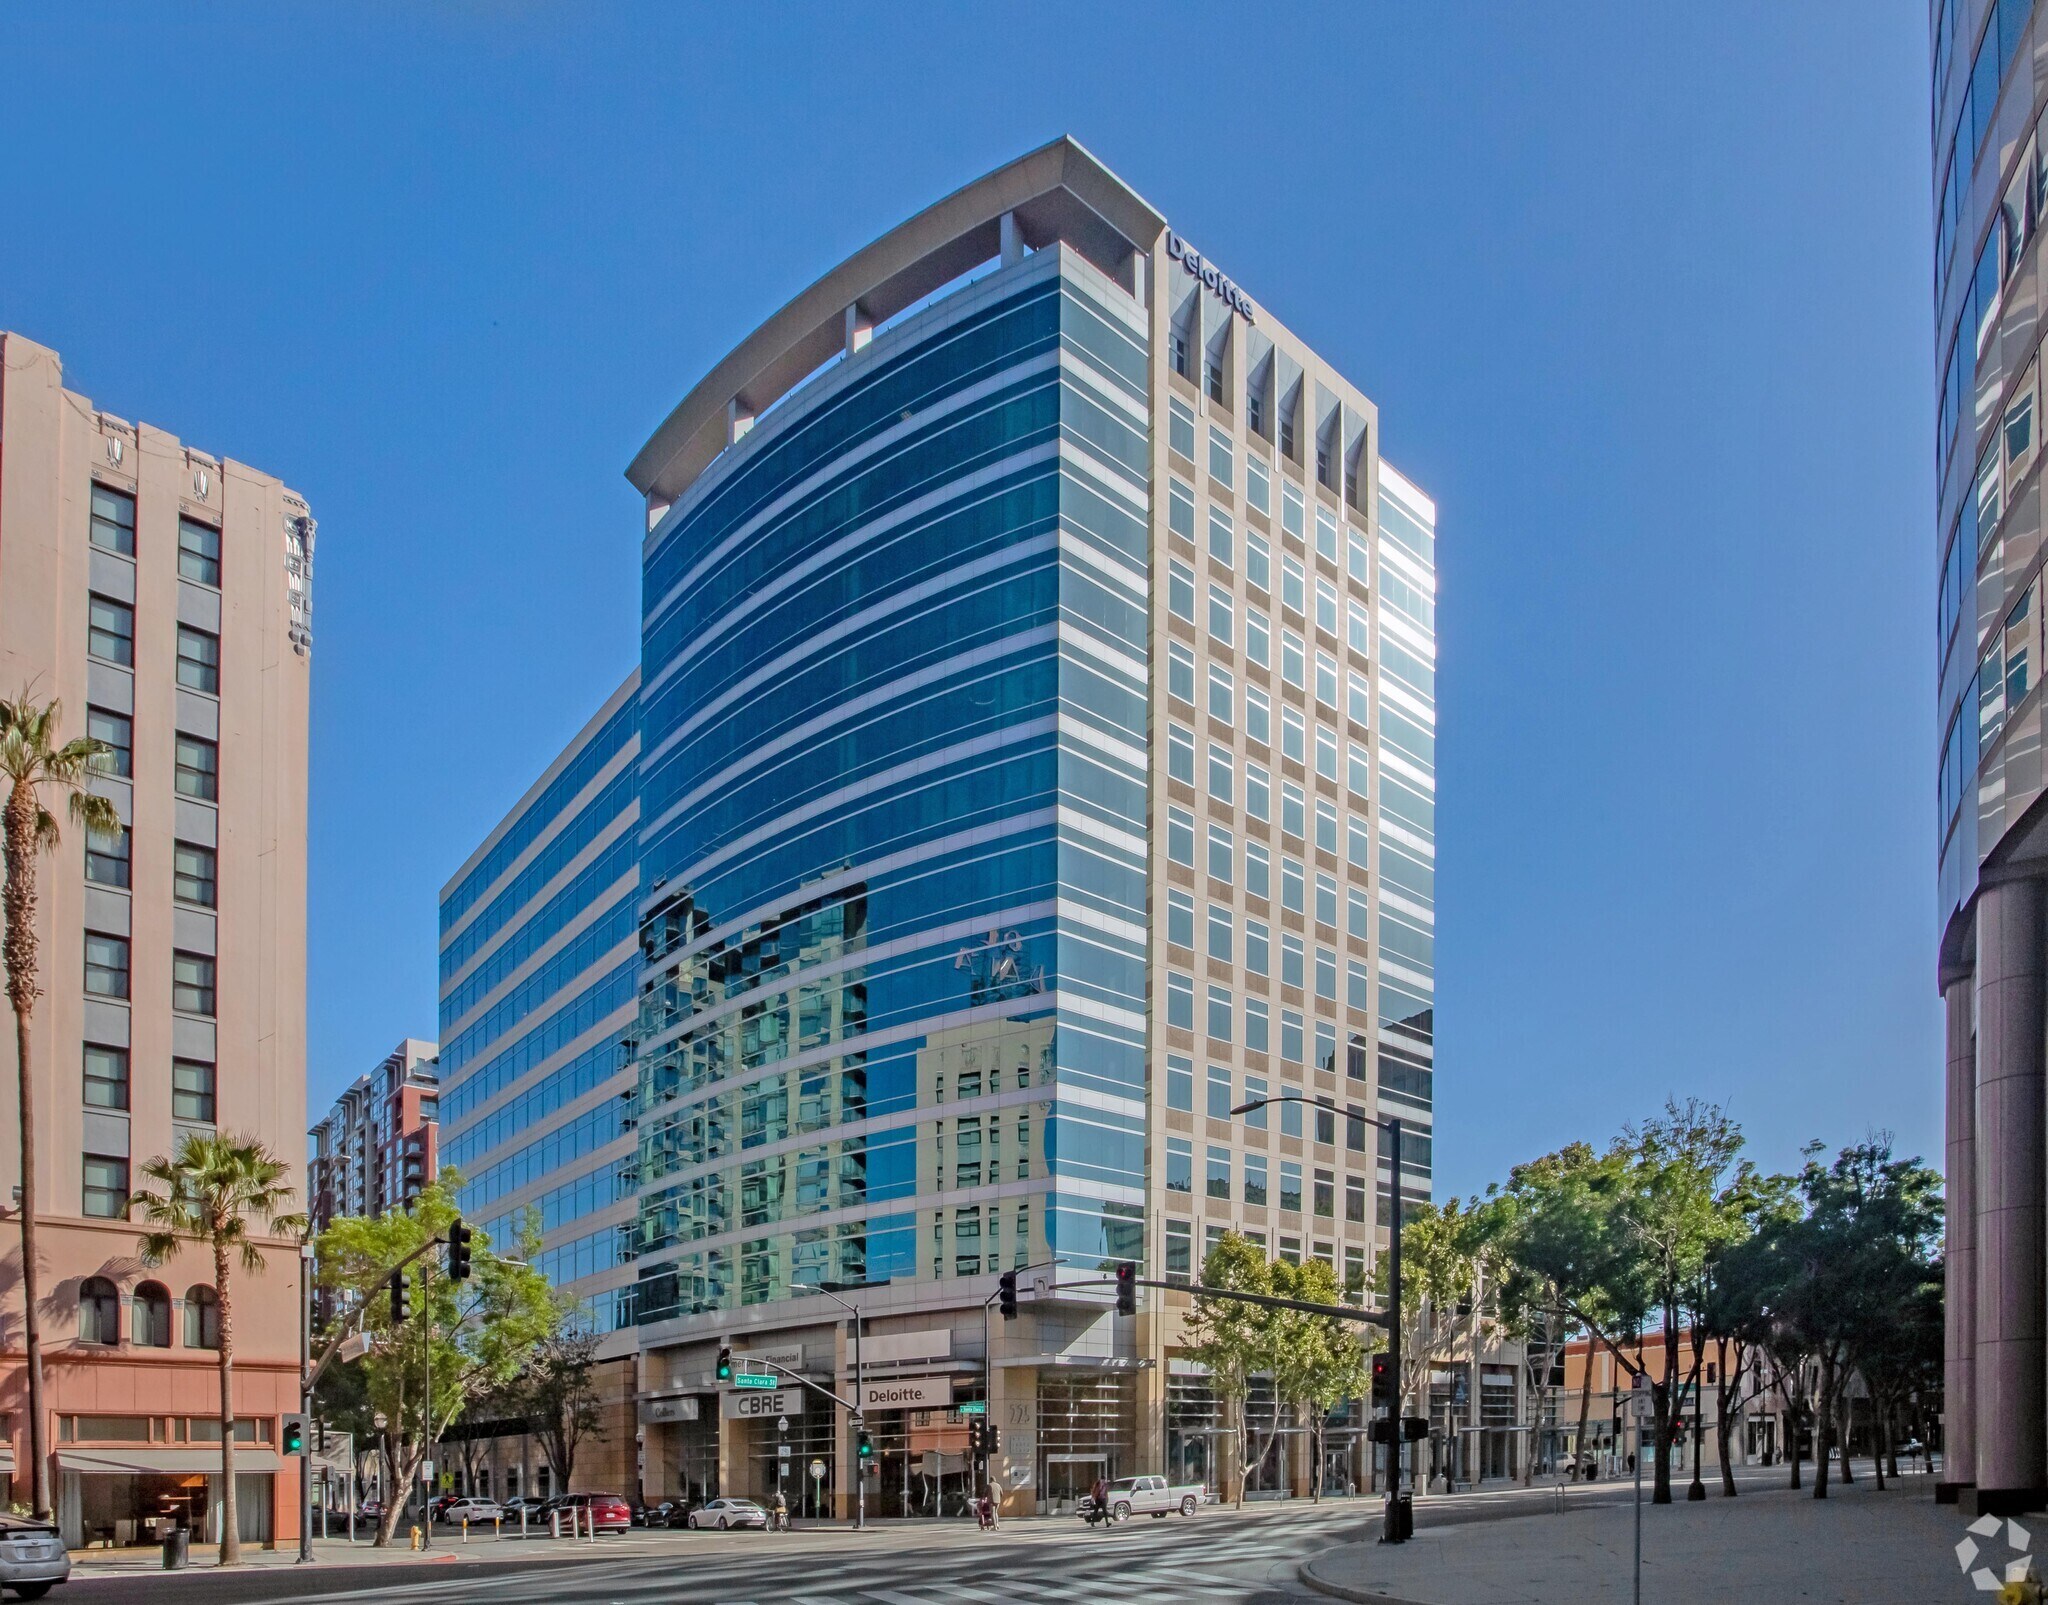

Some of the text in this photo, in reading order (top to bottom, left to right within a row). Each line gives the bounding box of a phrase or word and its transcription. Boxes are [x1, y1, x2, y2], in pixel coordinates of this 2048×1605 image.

[765, 1352, 799, 1364] Financial
[737, 1377, 753, 1385] Santa
[753, 1378, 768, 1386] Clara
[738, 1394, 784, 1415] CBRE
